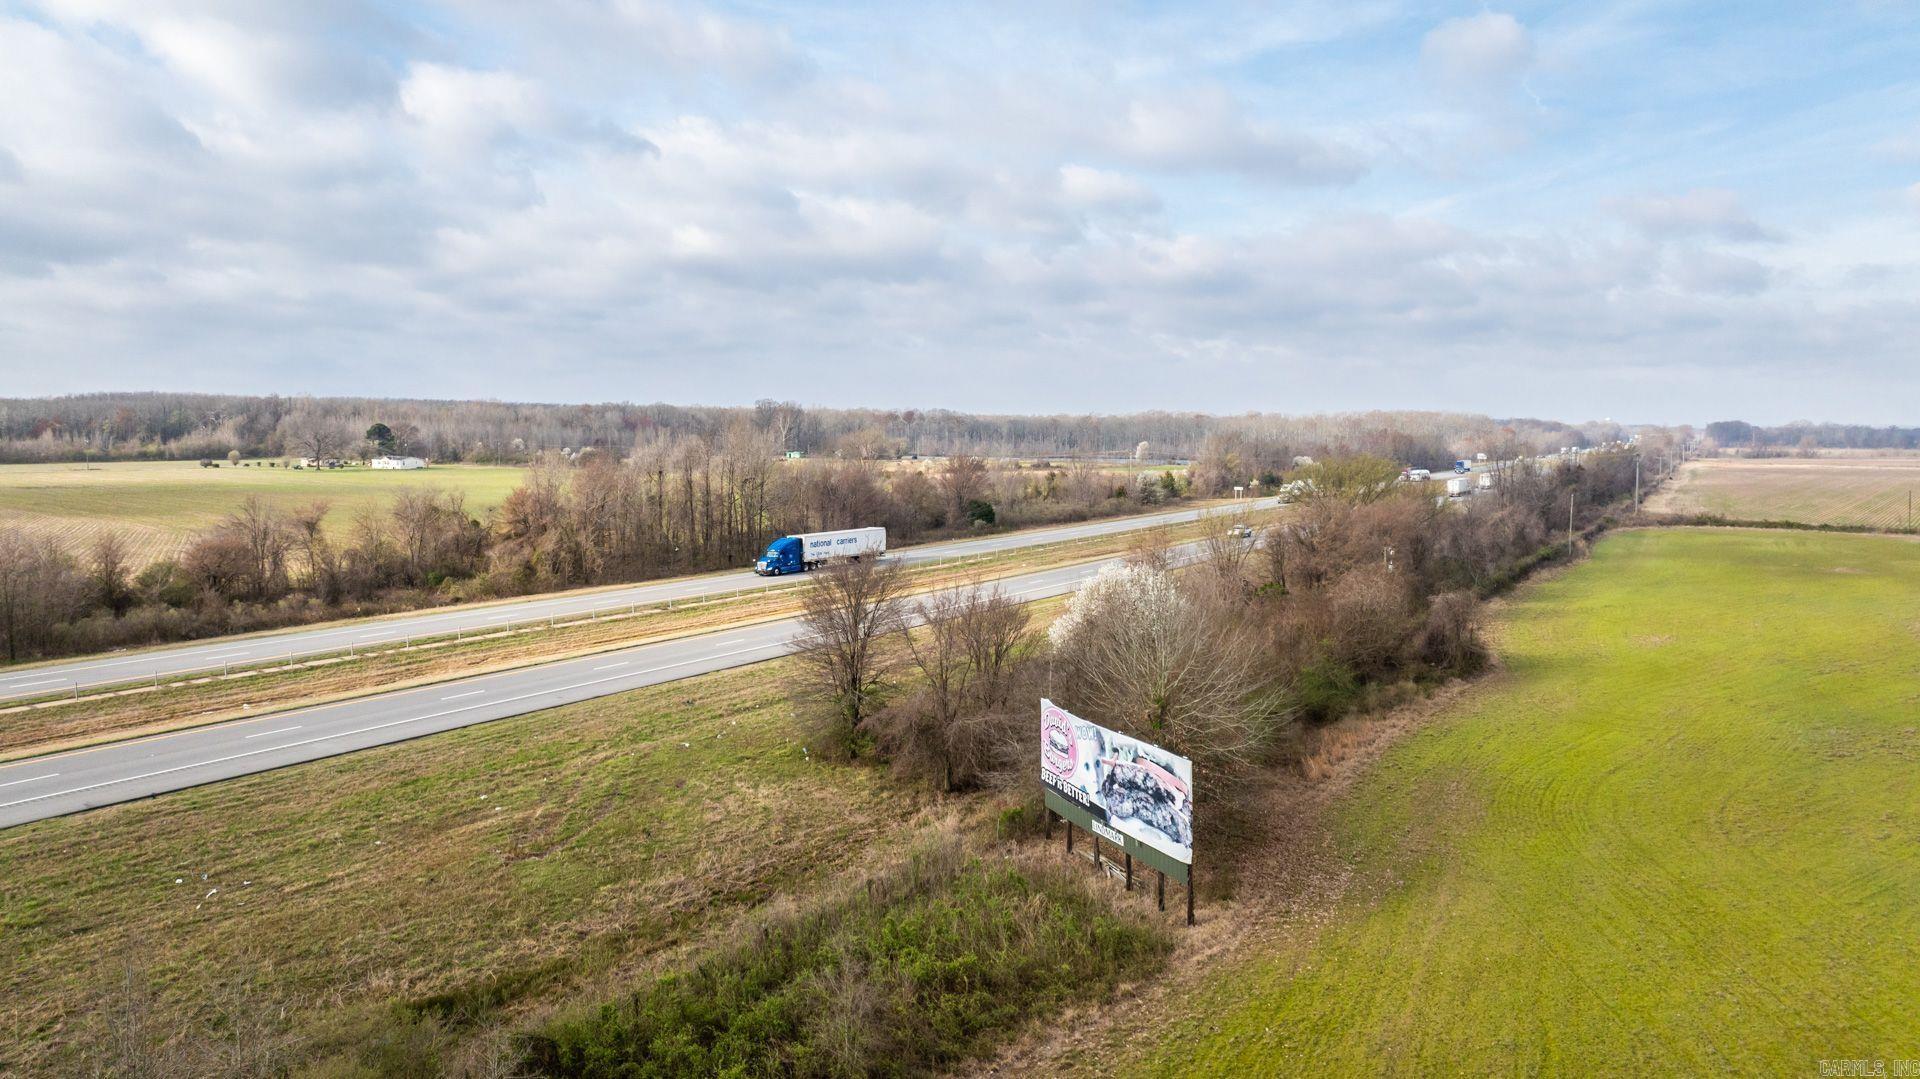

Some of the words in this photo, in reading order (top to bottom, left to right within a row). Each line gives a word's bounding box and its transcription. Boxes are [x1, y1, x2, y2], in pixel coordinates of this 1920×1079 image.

[809, 538, 832, 548] national
[836, 536, 858, 545] carriers
[1041, 767, 1057, 786] BEEF
[1063, 780, 1090, 807] BETTER!
